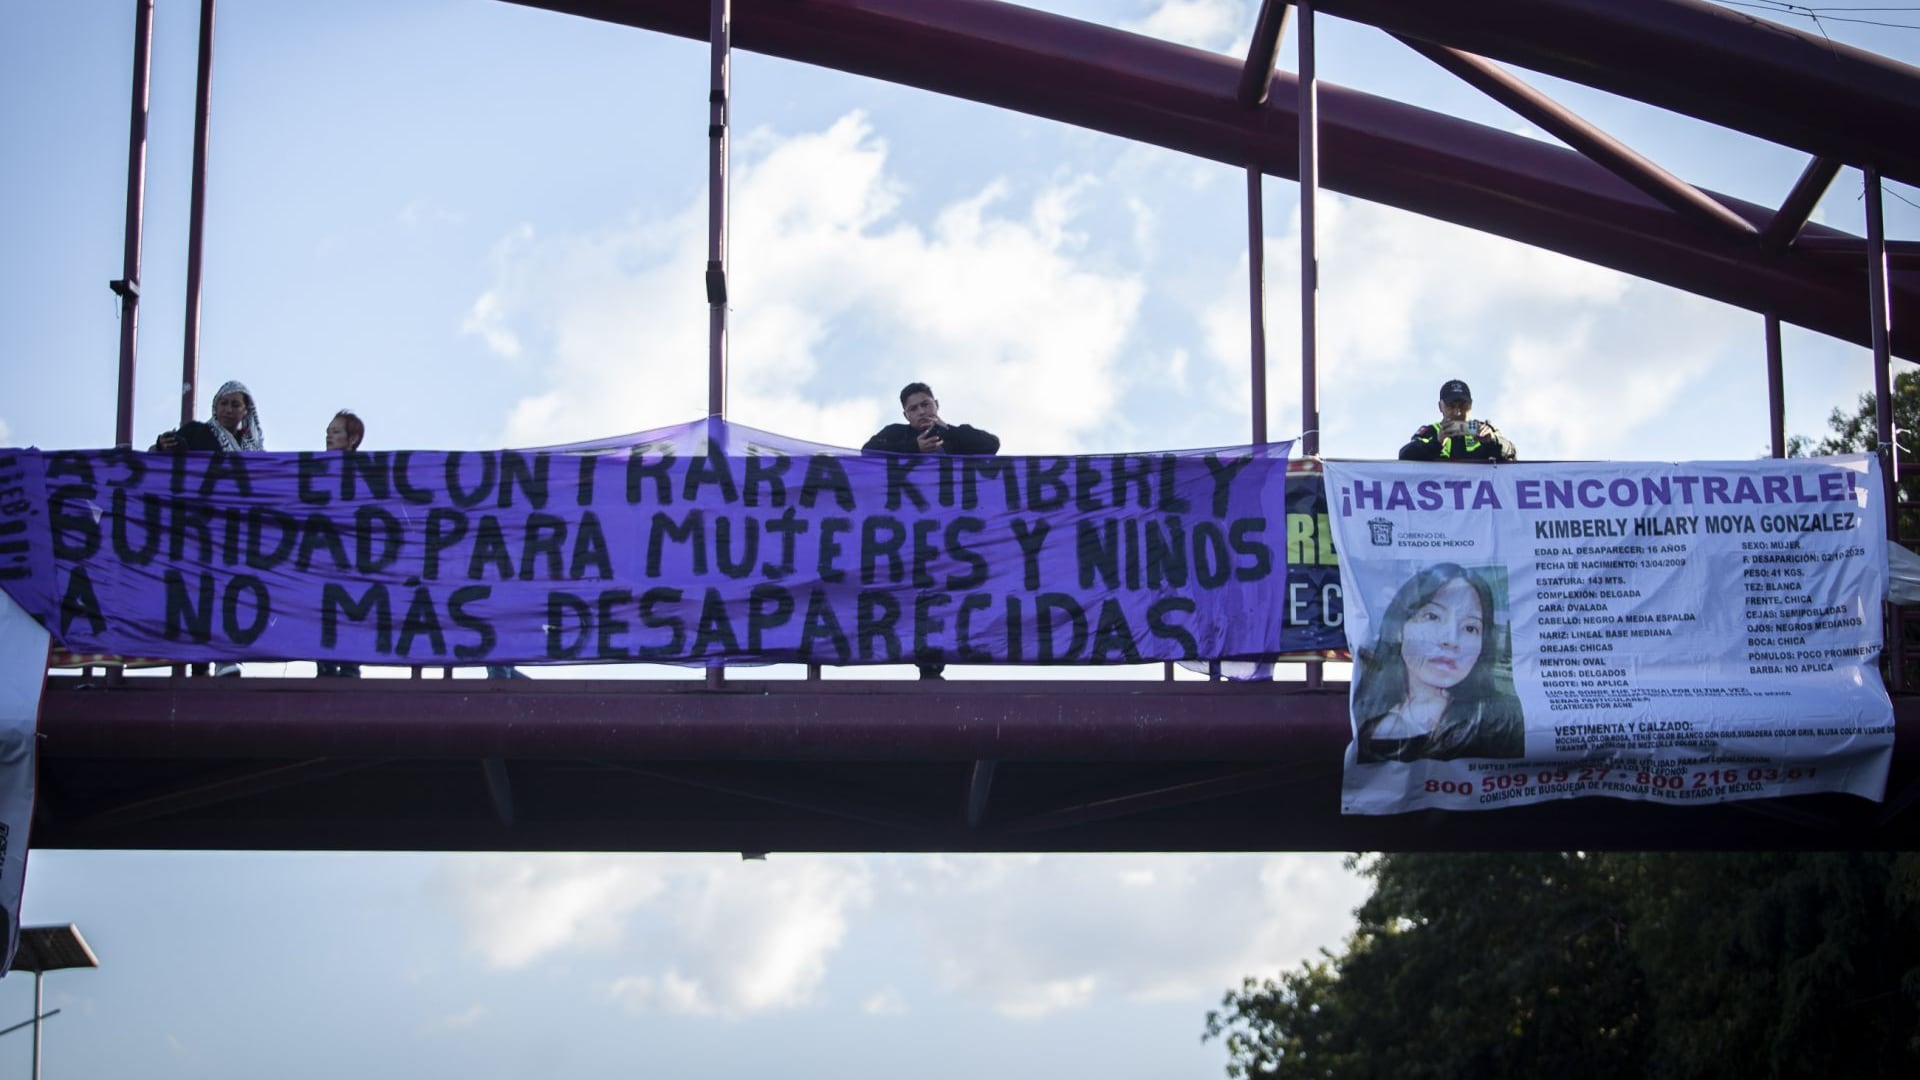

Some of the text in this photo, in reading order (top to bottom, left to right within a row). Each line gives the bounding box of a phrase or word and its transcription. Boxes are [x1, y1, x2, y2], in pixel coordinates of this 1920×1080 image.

[883, 453, 1255, 518] KIMBERLY
[1342, 471, 1857, 517] ¡HASTA ENCONTRARLE!
[1535, 512, 1855, 539] KIMBERLY HILARY MOYA GONZALEZ
[422, 508, 614, 580] PARA
[646, 506, 988, 590] MUJERES
[1011, 518, 1051, 591] Y
[1535, 548, 1559, 556] EDAD
[1576, 546, 1645, 555] DESAPARECER:
[1660, 544, 1686, 553] AÑOS
[1741, 541, 1800, 550] SEXO: MUJER
[1536, 562, 1565, 570] FECHA
[1567, 561, 1579, 569] DE
[1581, 560, 1638, 569] NACIMIENTO:
[1744, 569, 1770, 577] PESO:
[1771, 569, 1781, 577] 41
[1536, 578, 1585, 586] ESTATURA:
[1766, 582, 1802, 590] BLANCA
[1600, 590, 1641, 598] DELGADA
[1289, 583, 1309, 625] E
[1785, 596, 1812, 604] CHICA
[60, 565, 1198, 662] A NO MÁS DESAPARECIDAS
[1567, 604, 1608, 612] OVALADA
[1746, 605, 1847, 619] CEJAS: SEMIPOBLADAS
[1538, 617, 1582, 625] CABELLO:
[1583, 616, 1615, 624] NEGRO
[1625, 615, 1654, 623] MEDIA
[1656, 613, 1696, 622] ESPALDA
[1747, 617, 1862, 632] OJOS: NEGROS MEDIANOS
[1539, 629, 1672, 640] NARIZ: LINEAL BASE MEDIANA
[1748, 637, 1805, 646] BOCA: CHICA
[1540, 644, 1613, 653] OREJAS: CHICAS
[1798, 651, 1822, 659] POCO
[1583, 658, 1606, 666] OVAL
[1541, 669, 1626, 678] LABIOS: DELGADOS
[1750, 664, 1834, 674] BARBA: NO APLICA
[1555, 721, 1693, 736] VESTIMENTA Y CALZADO:
[1676, 732, 1703, 740] BLANCO
[1705, 731, 1719, 739] CON
[1774, 729, 1796, 737] COLOR
[1817, 728, 1839, 736] BLUSA
[1840, 727, 1862, 736] COLOR
[1424, 780, 1473, 796] 800
[1481, 773, 1528, 792] 509
[1537, 771, 1568, 784] 09
[1578, 768, 1611, 782] 27
[1636, 772, 1684, 789] 800
[1692, 769, 1738, 788] 216
[1747, 768, 1778, 781] 03
[1525, 786, 1536, 797] DE
[1588, 780, 1600, 789] DE
[1602, 781, 1649, 794] PERSONAS
[1652, 788, 1663, 798] EN
[1666, 789, 1677, 799] EL
[1679, 787, 1713, 800] ESTADO
[1715, 786, 1726, 795] DE
